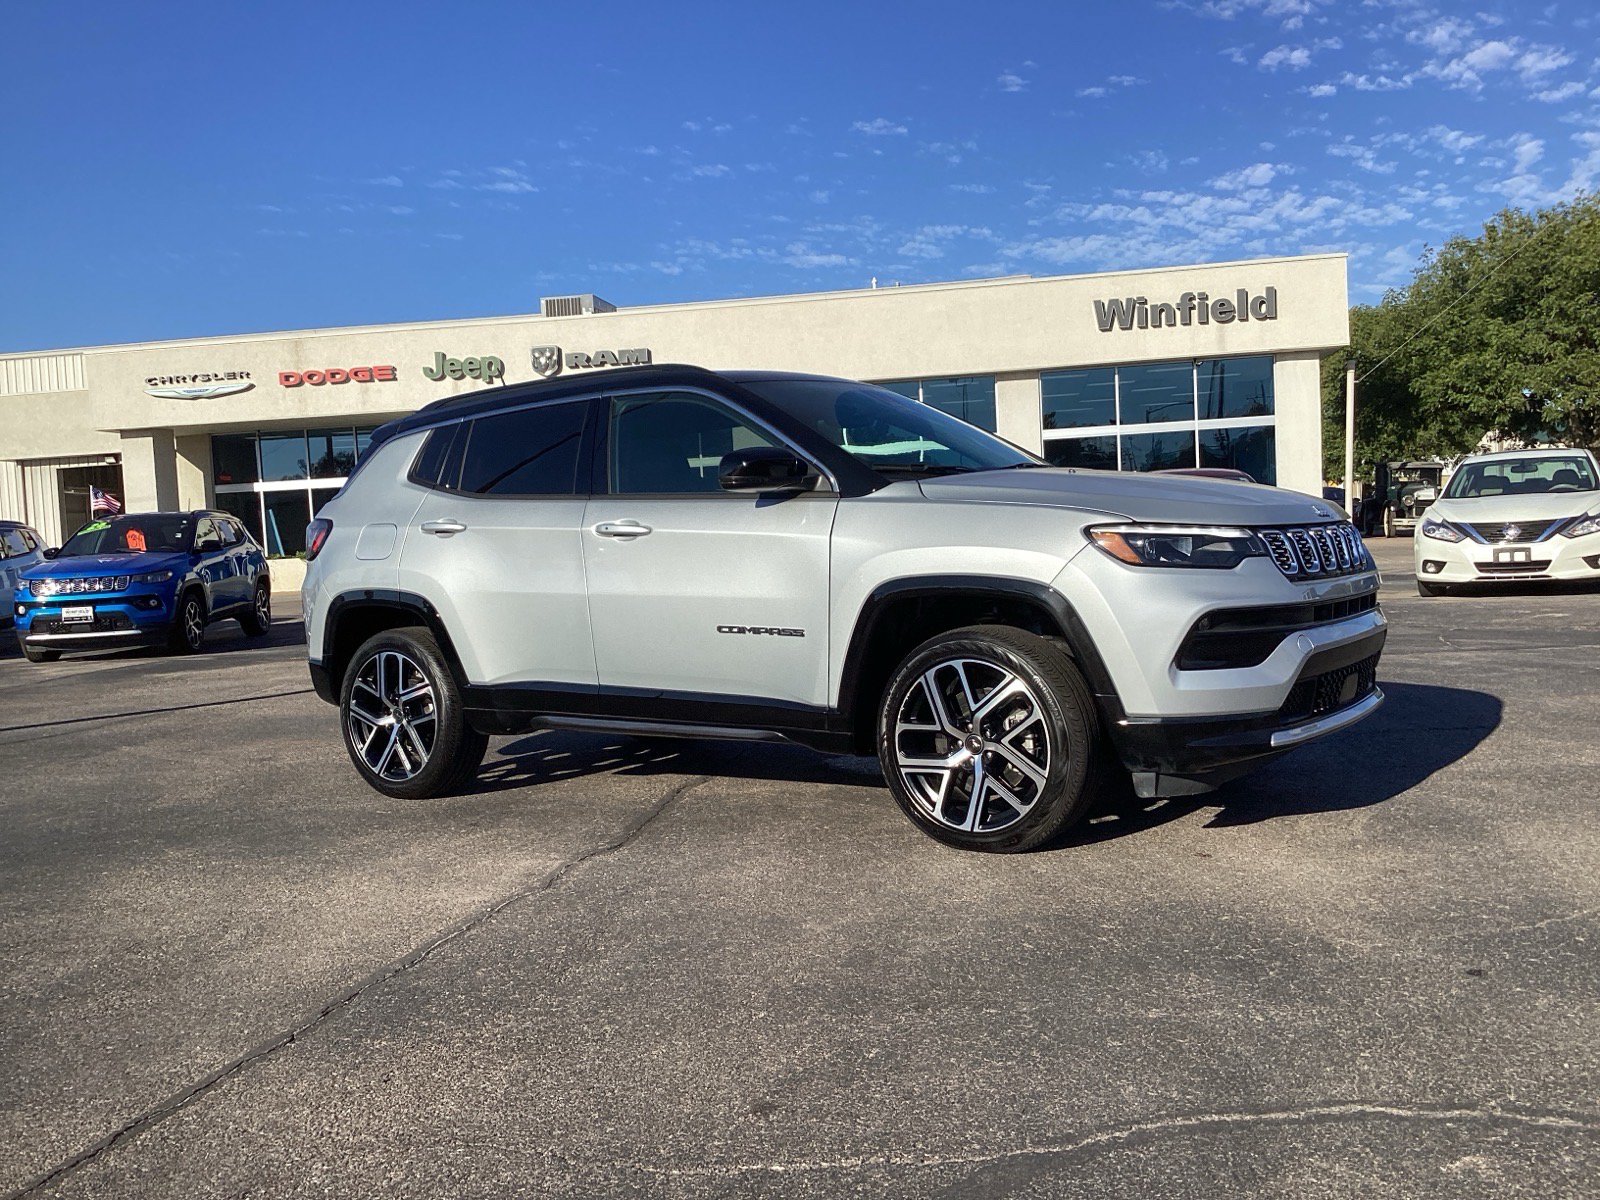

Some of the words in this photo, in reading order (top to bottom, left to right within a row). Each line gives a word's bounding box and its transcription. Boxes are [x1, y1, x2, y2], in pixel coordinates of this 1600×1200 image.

[1093, 286, 1277, 332] Winfield
[422, 351, 505, 384] Jeep
[565, 347, 652, 369] RAM
[145, 371, 251, 386] CHRYSLER
[278, 365, 398, 388] DODGE
[717, 625, 805, 637] COMPASS
